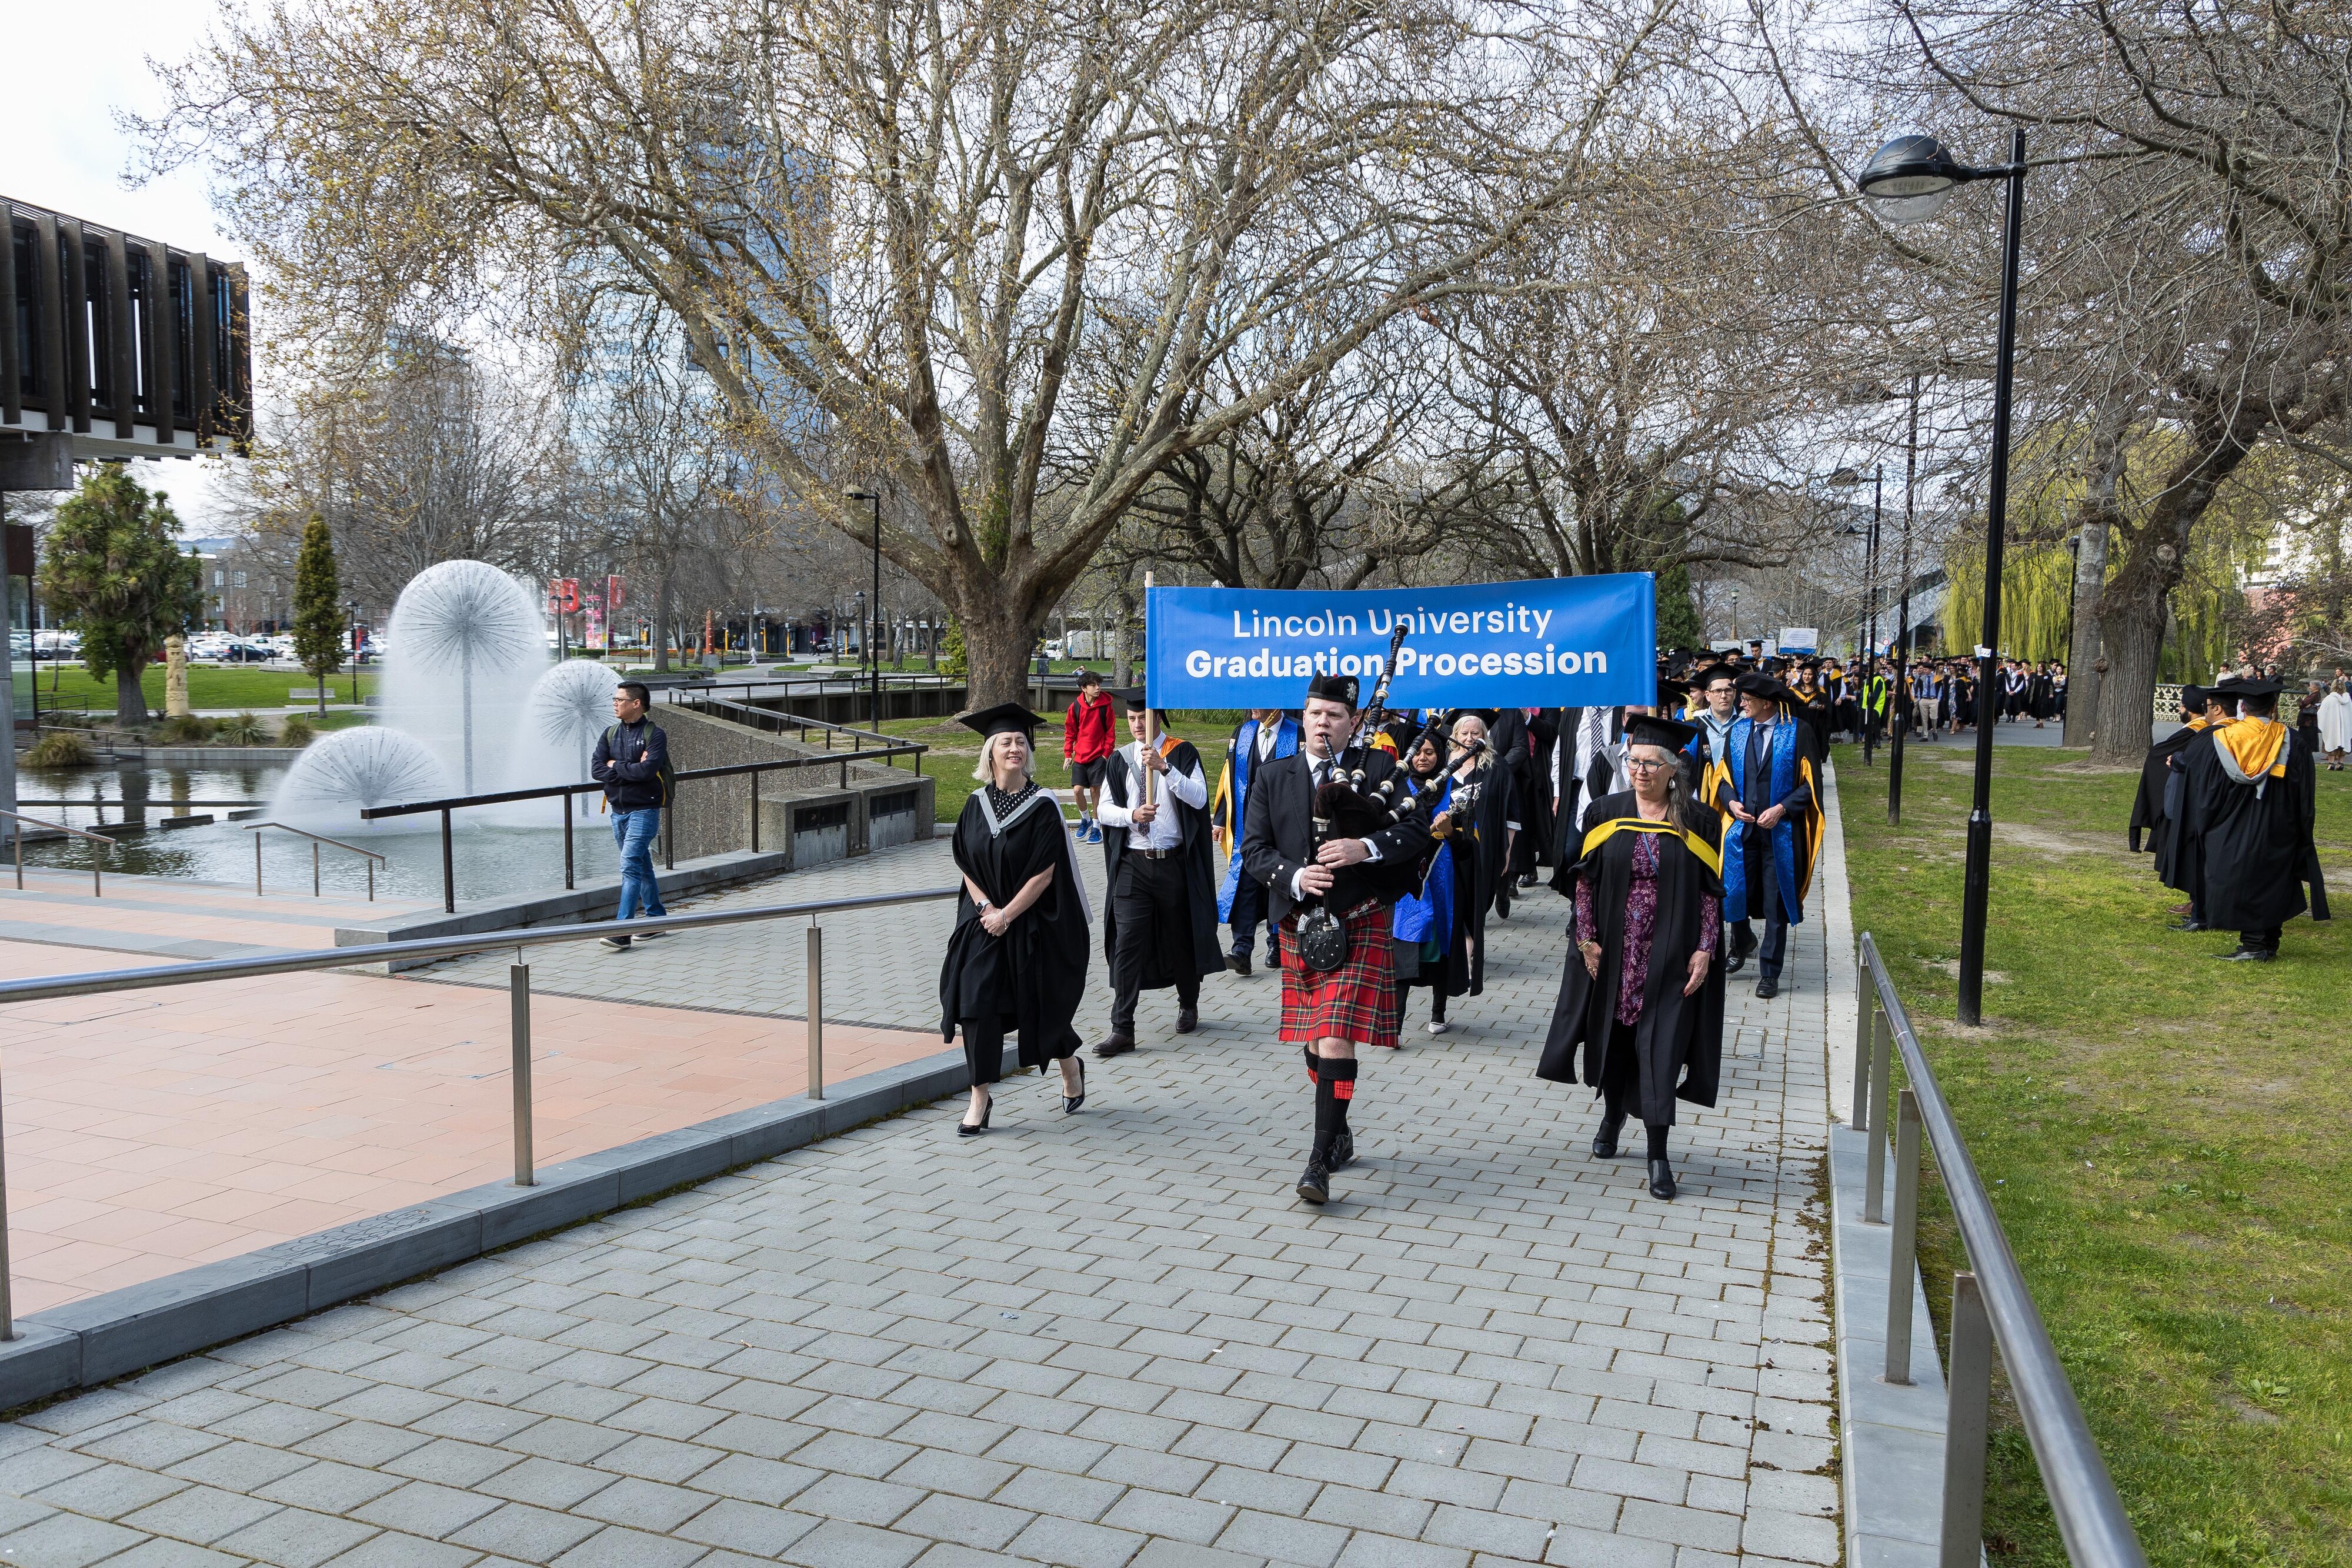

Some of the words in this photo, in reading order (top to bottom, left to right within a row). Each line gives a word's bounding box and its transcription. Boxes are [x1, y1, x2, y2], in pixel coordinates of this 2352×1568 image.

[1233, 609, 1357, 638] Lincoln
[1367, 602, 1553, 639] University
[1185, 646, 1384, 678] Graduation
[1394, 643, 1607, 676] Procession
